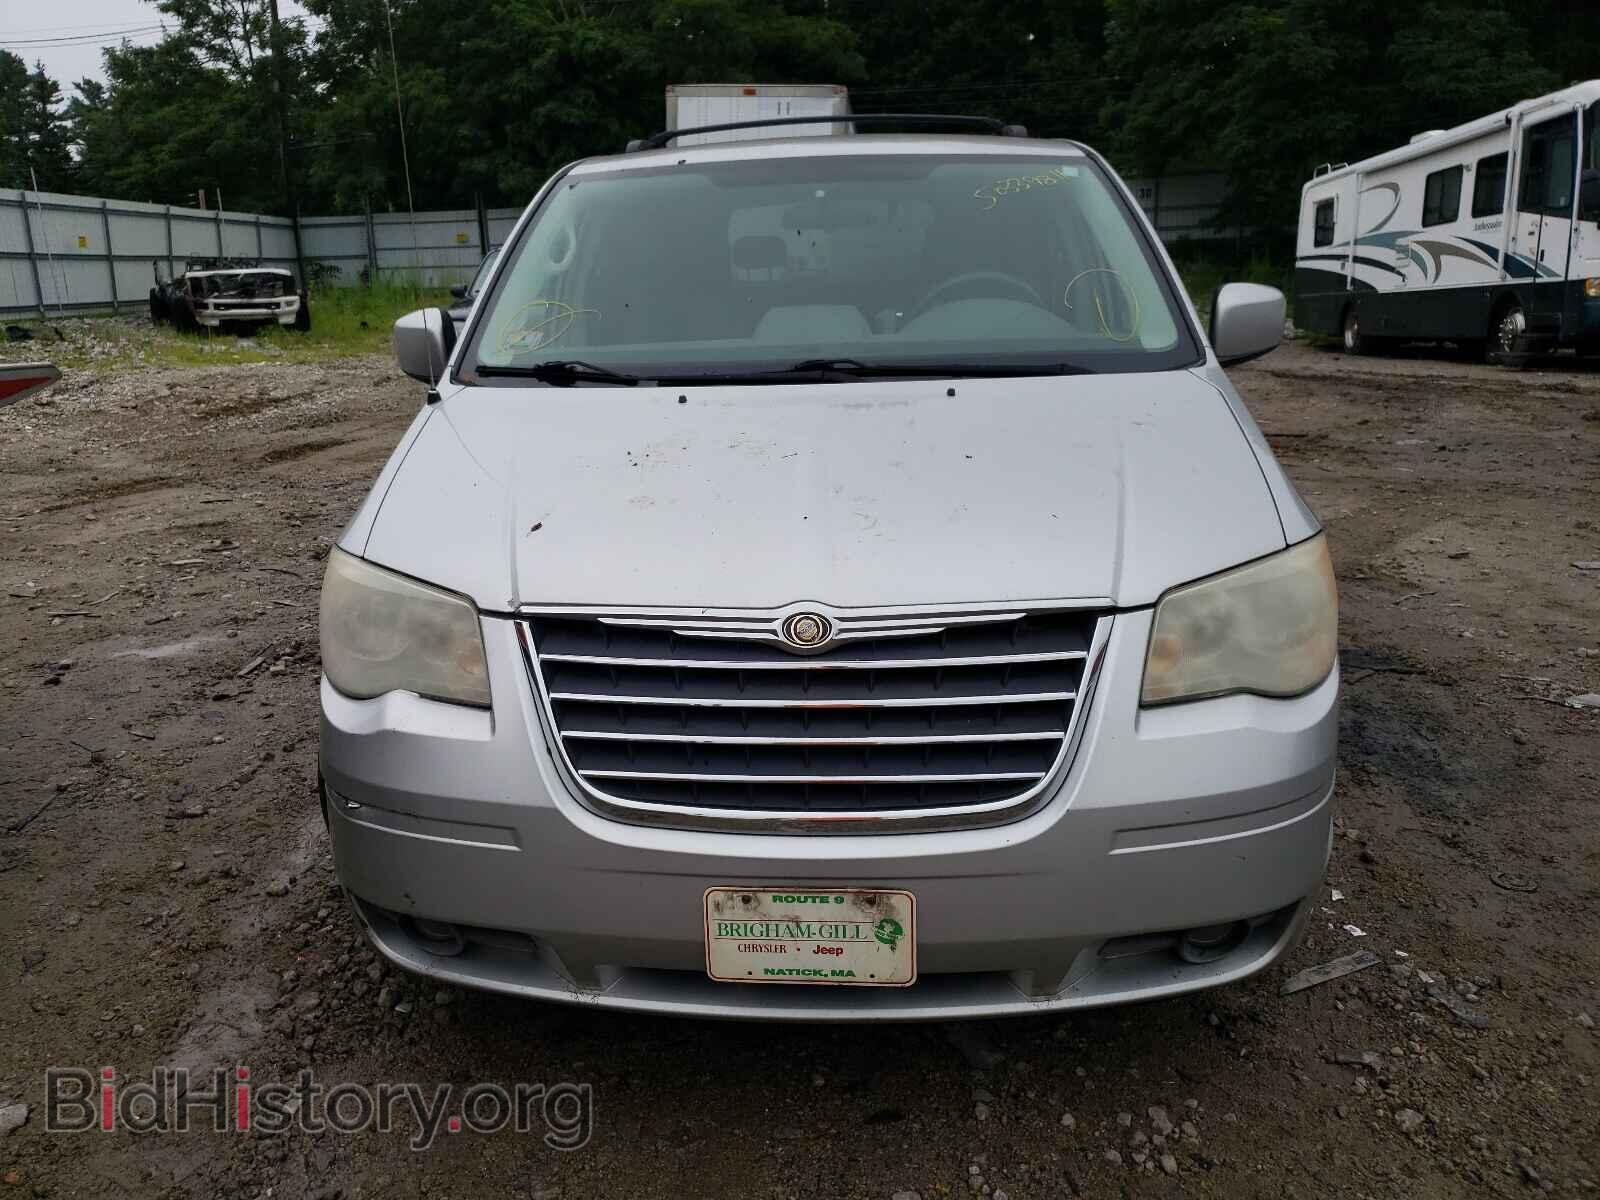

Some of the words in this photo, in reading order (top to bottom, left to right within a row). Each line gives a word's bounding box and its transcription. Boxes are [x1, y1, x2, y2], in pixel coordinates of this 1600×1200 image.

[772, 895, 830, 905] ROUTE
[833, 895, 845, 905] 9
[717, 922, 868, 940] BRIGHAM-GILL
[737, 943, 788, 954] CHRYSLER
[812, 944, 844, 957] Jeep
[763, 968, 829, 978] NATICK,
[831, 969, 857, 978] MA
